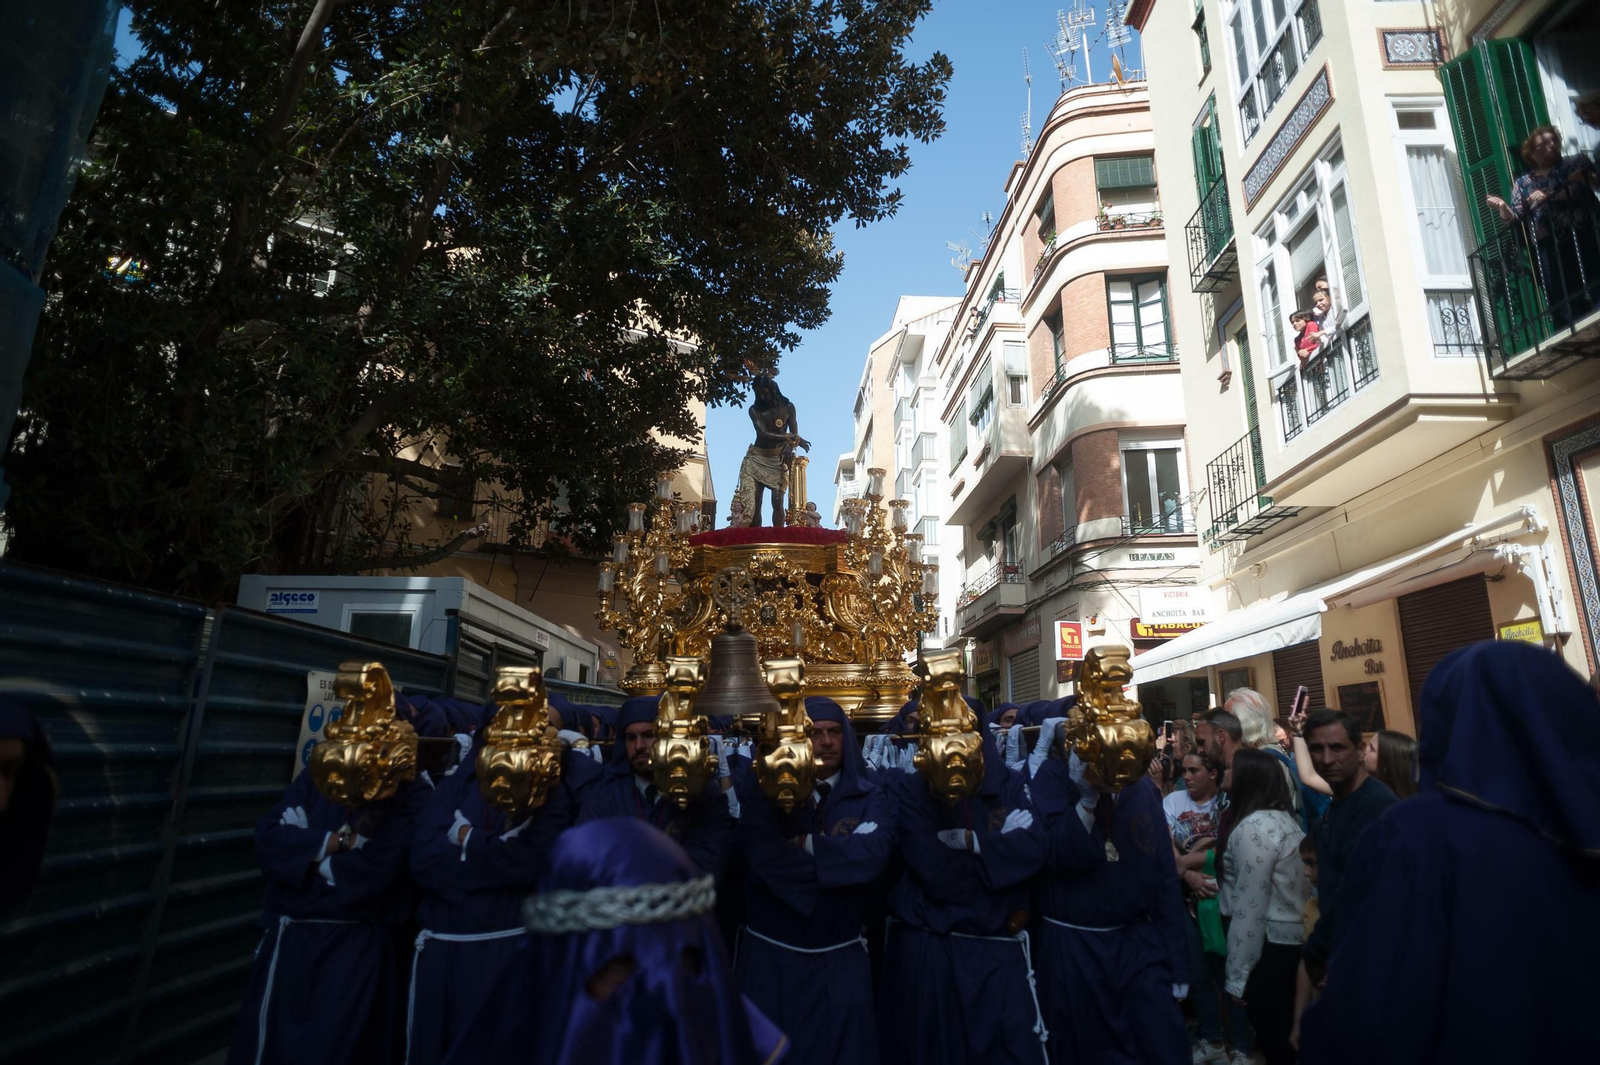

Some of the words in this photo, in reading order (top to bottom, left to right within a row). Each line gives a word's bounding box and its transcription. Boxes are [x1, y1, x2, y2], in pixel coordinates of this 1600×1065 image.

[1128, 552, 1175, 561] BEATAS
[1151, 610, 1187, 618] ANCHOITA
[1330, 637, 1383, 661] Anchoita
[1364, 658, 1385, 674] Bar
[320, 680, 327, 690] ES
